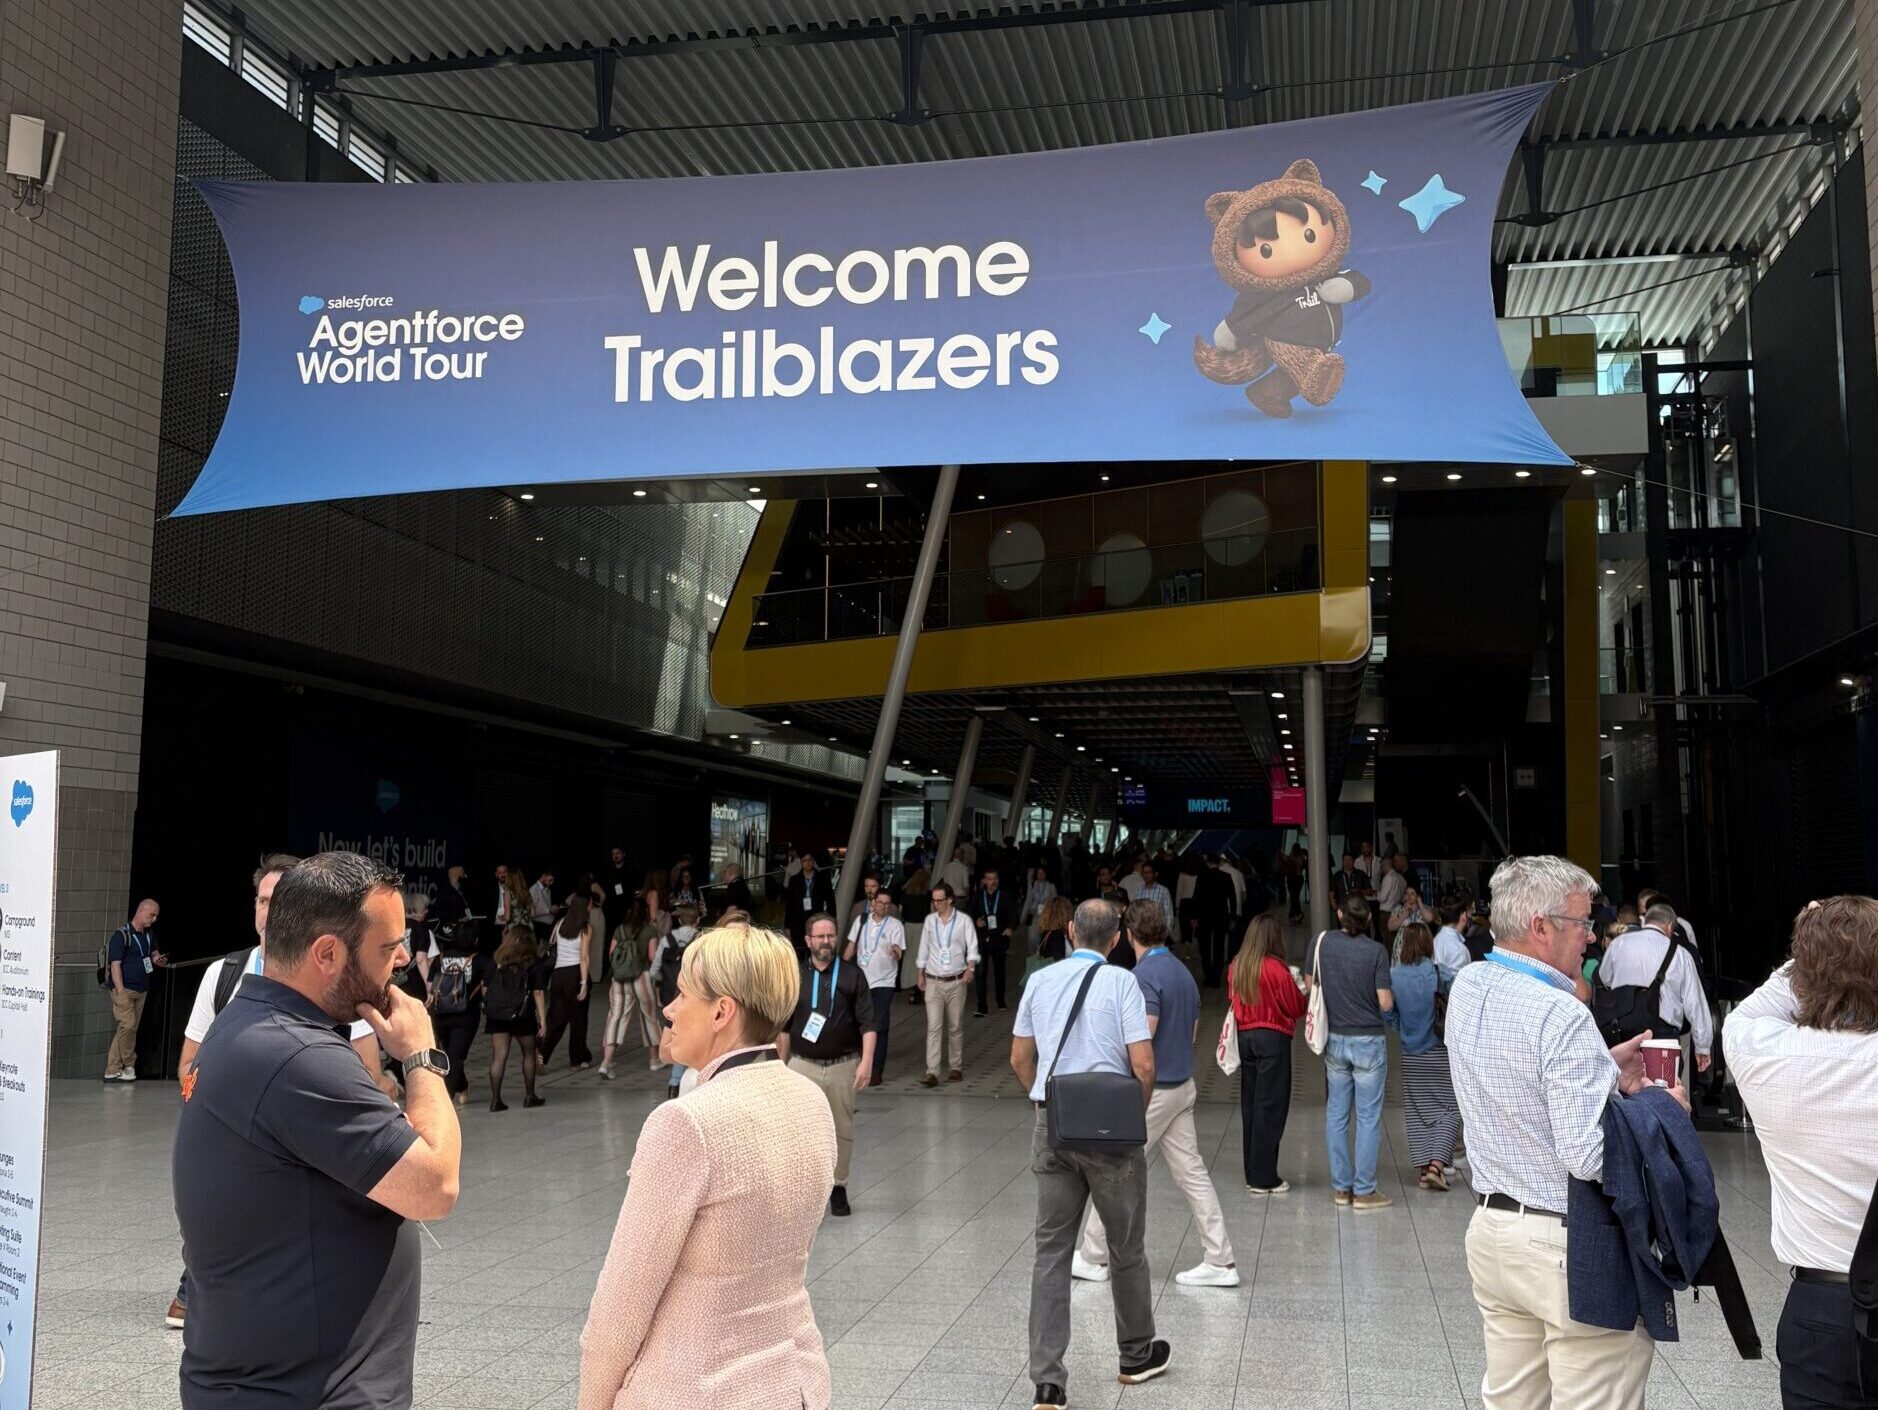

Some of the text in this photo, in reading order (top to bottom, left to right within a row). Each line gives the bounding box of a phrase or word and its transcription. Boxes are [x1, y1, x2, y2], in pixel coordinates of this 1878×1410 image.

[633, 240, 1030, 313] Welcome
[328, 294, 394, 311] salesforce
[309, 309, 525, 356] Agentforce
[296, 346, 488, 385] World Tour
[604, 325, 1060, 402] Trailblazers
[404, 837, 447, 868] build
[5, 914, 35, 929] Campground
[4, 949, 22, 961] Content
[2, 985, 45, 1003] Hands-on Trainings
[16, 1193, 33, 1210] Summit
[11, 1229, 22, 1244] Suite
[13, 1267, 27, 1284] Event
